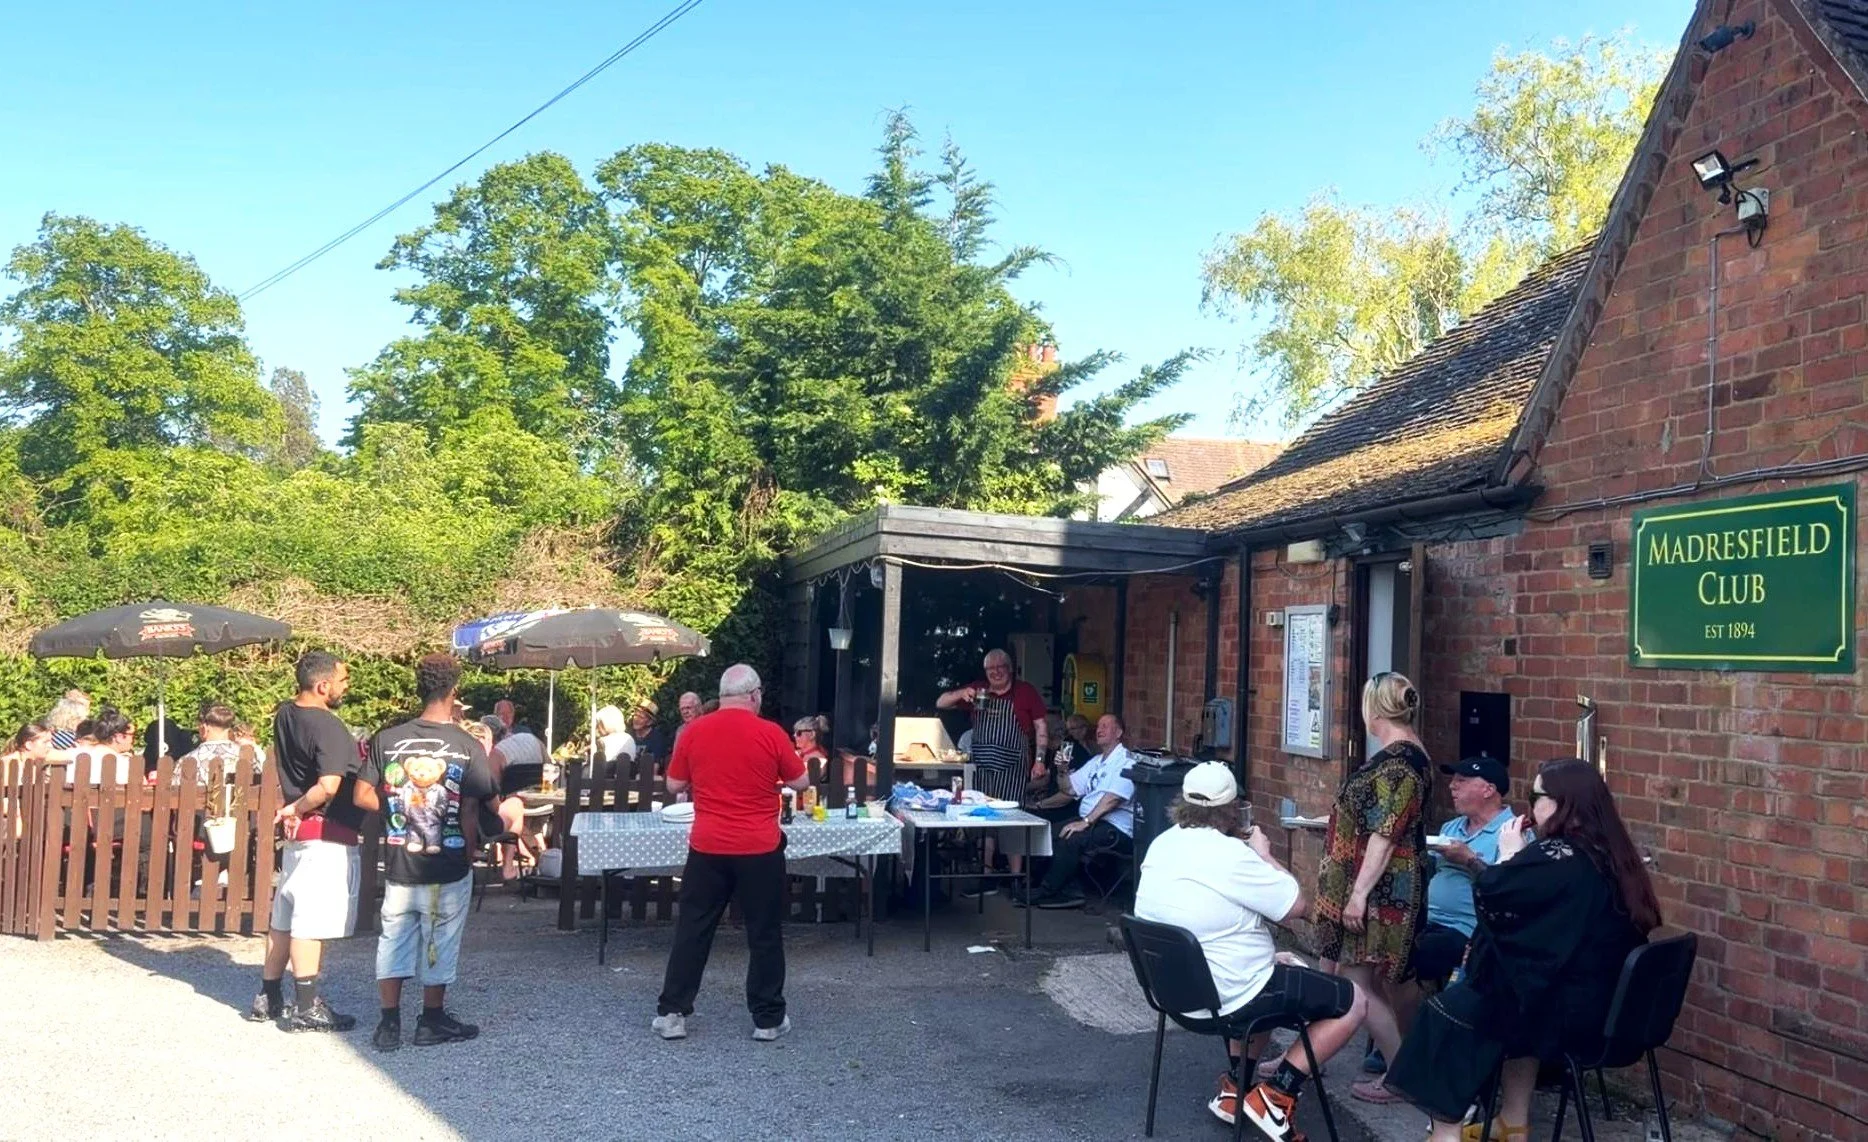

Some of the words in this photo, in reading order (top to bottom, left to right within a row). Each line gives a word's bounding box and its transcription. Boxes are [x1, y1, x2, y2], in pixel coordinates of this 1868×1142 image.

[1648, 522, 1831, 566] MADRESFIELD
[1698, 571, 1766, 605] CLUB
[1704, 624, 1725, 639] EST
[1728, 622, 1756, 639] 1894
